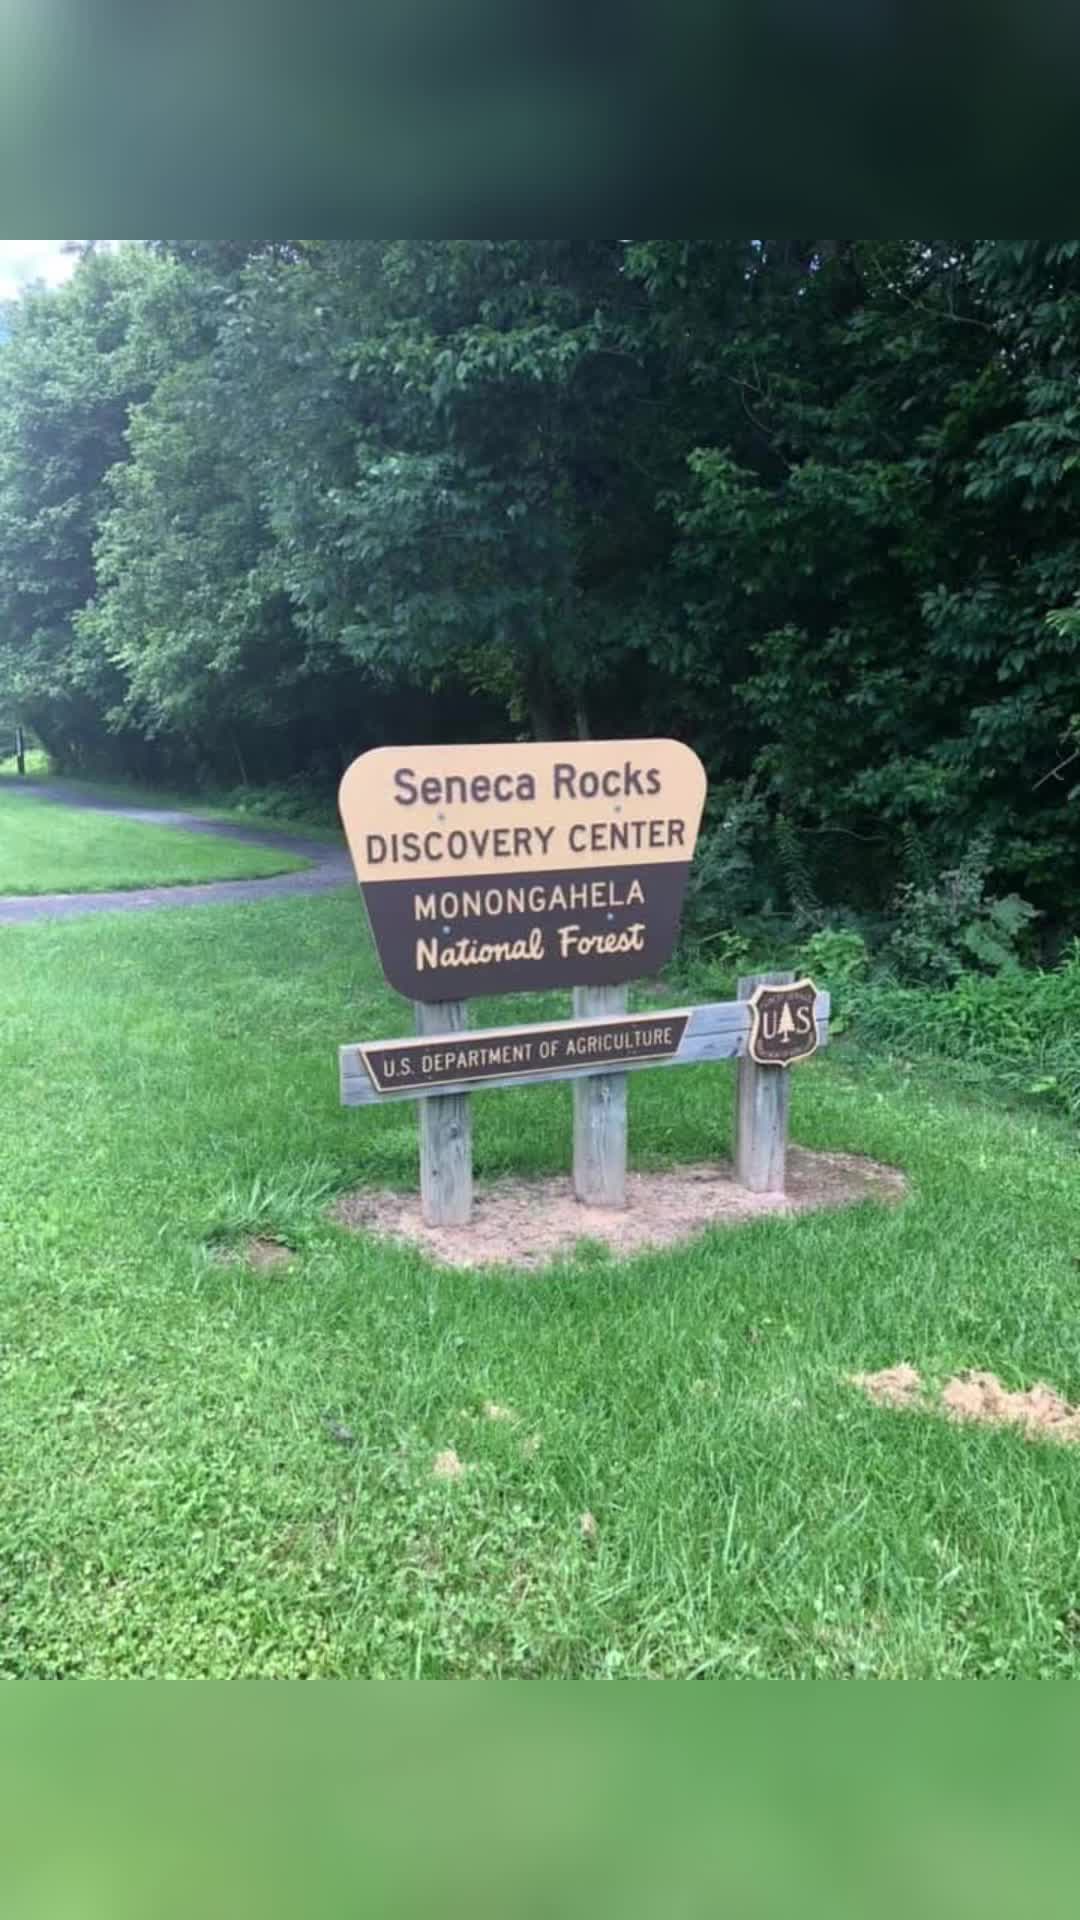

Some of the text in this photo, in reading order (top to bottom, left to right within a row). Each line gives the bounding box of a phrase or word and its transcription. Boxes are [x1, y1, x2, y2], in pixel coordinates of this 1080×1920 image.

[394, 761, 661, 805] Seneca Rocks
[366, 819, 685, 864] DISCOVERY CENTER
[414, 879, 645, 921] MONONGAHELA
[416, 923, 645, 971] National Forest
[383, 1027, 672, 1078] U.S. DEPARTMENT OF AGRICULTURE
